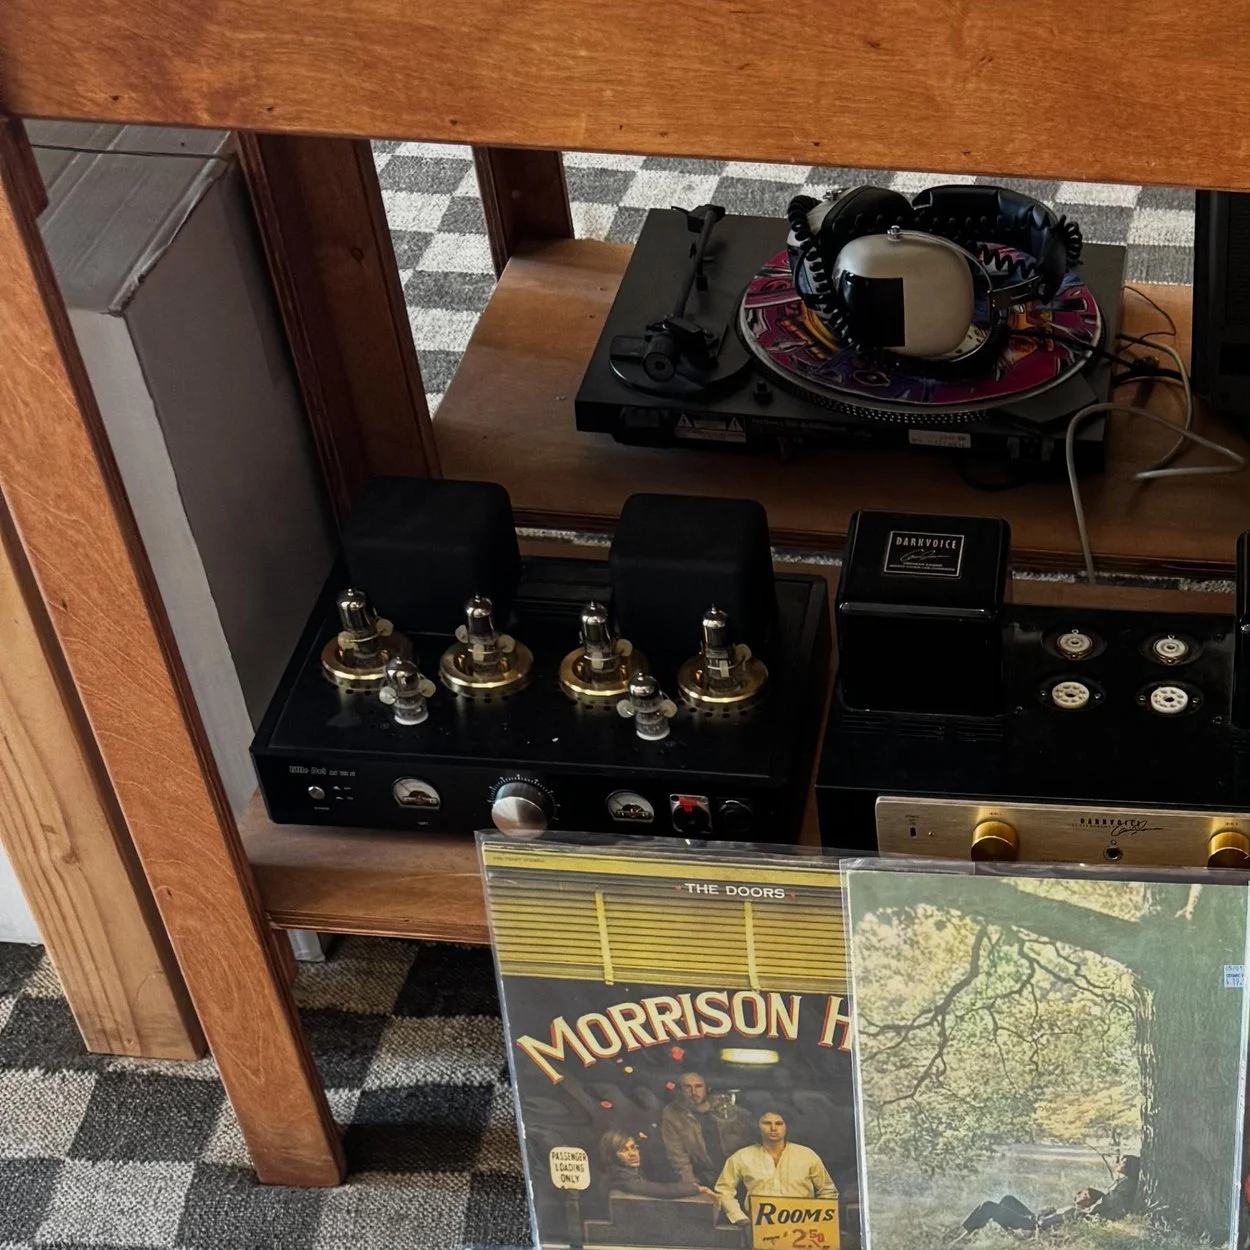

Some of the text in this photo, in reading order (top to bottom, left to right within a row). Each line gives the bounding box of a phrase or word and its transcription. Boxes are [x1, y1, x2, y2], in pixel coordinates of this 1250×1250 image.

[896, 536, 957, 550] DARKVOICE
[684, 883, 785, 899] THE DOORS
[516, 990, 802, 1085] MORRISON
[552, 1151, 587, 1162] PASSENGER
[555, 1162, 585, 1173] LOADING
[560, 1173, 580, 1184] ONLY
[755, 1202, 836, 1226] ROOMS
